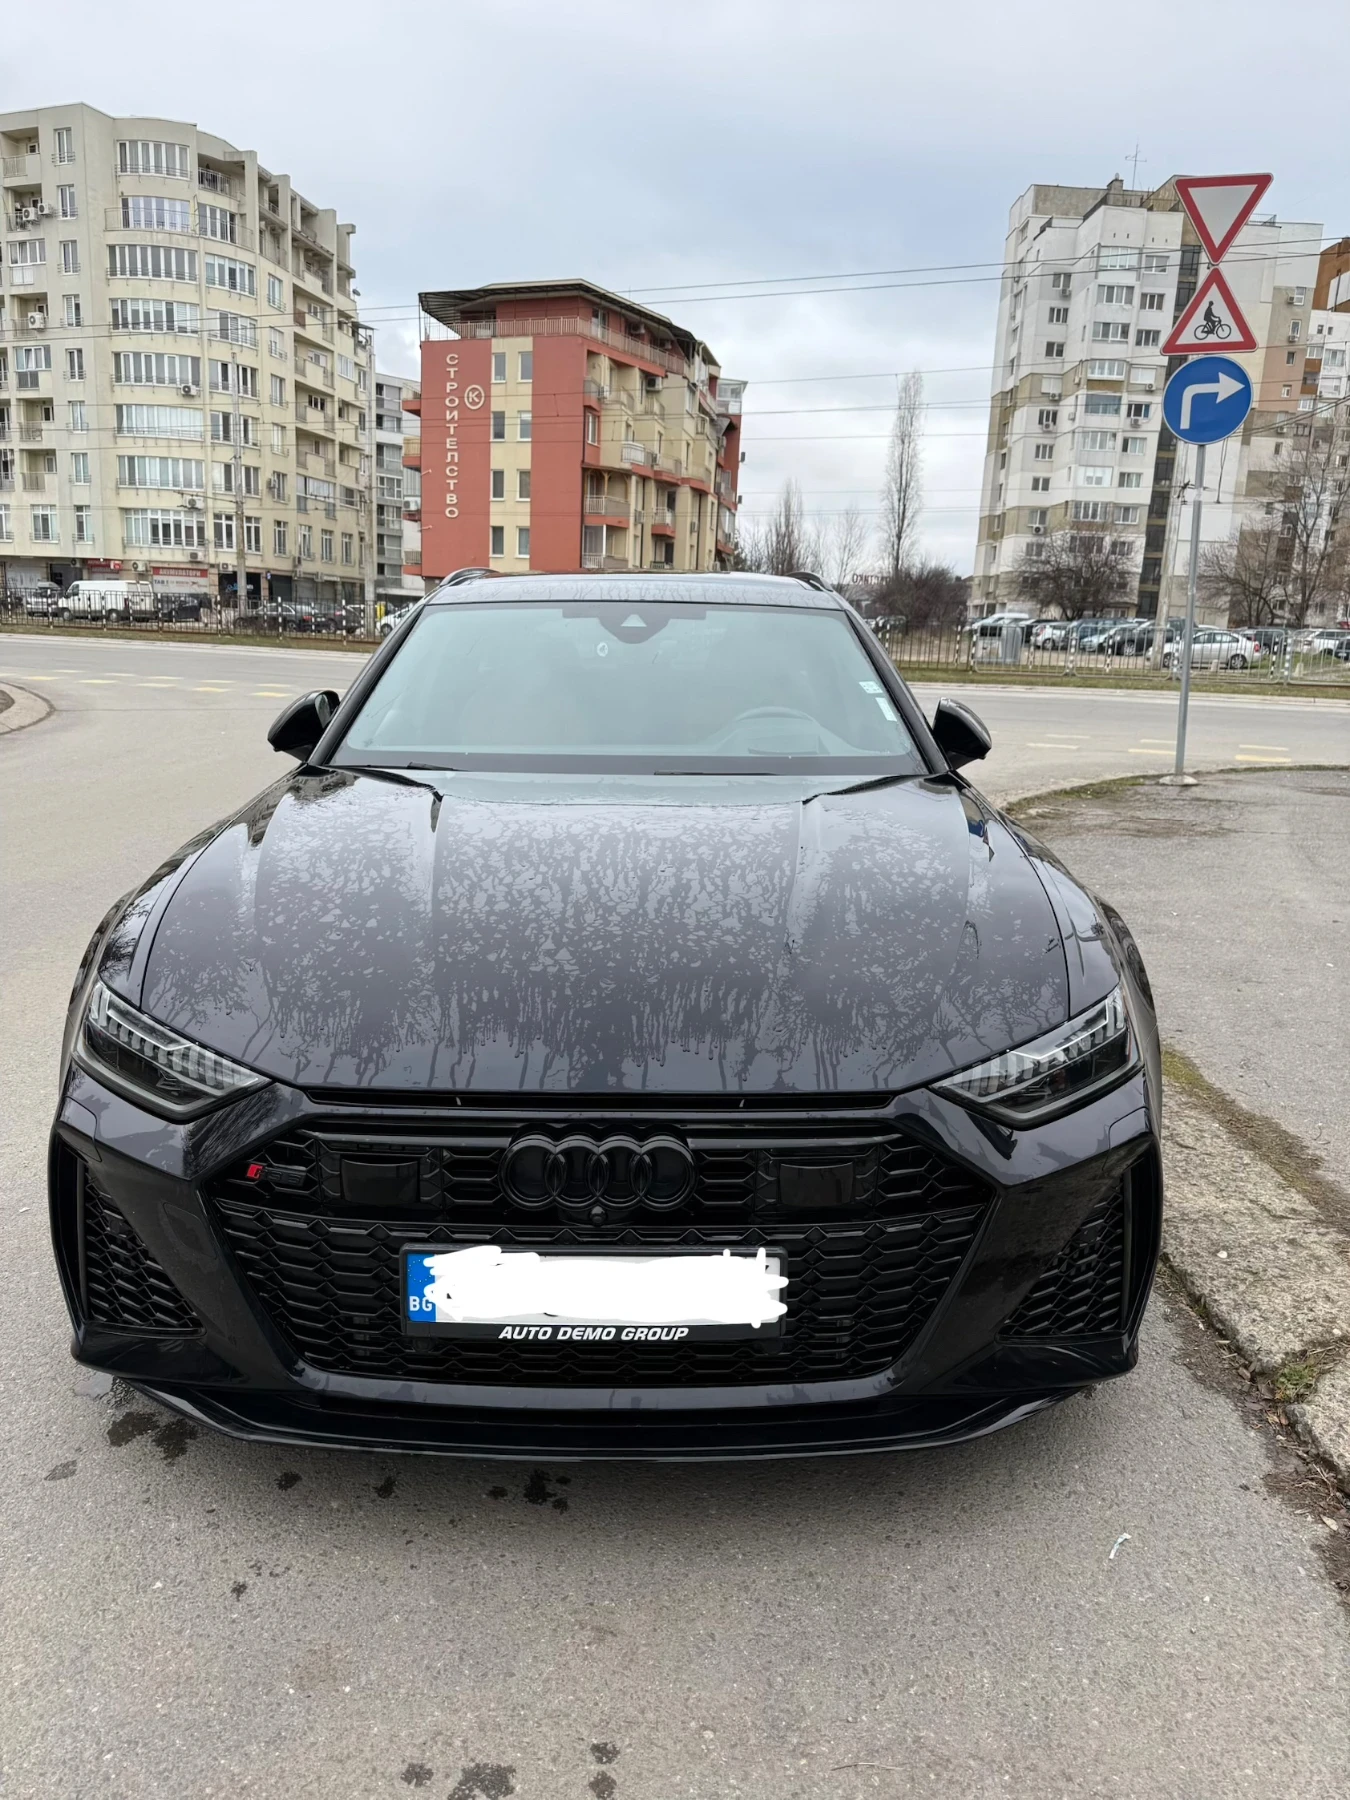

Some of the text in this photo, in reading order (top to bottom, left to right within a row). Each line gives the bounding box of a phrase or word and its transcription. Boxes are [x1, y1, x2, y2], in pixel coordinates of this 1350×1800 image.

[445, 353, 459, 518] СТРОИТЕЛСТВО
[409, 1296, 433, 1312] BG
[498, 1326, 690, 1341] AUTO DEMO GROUP
